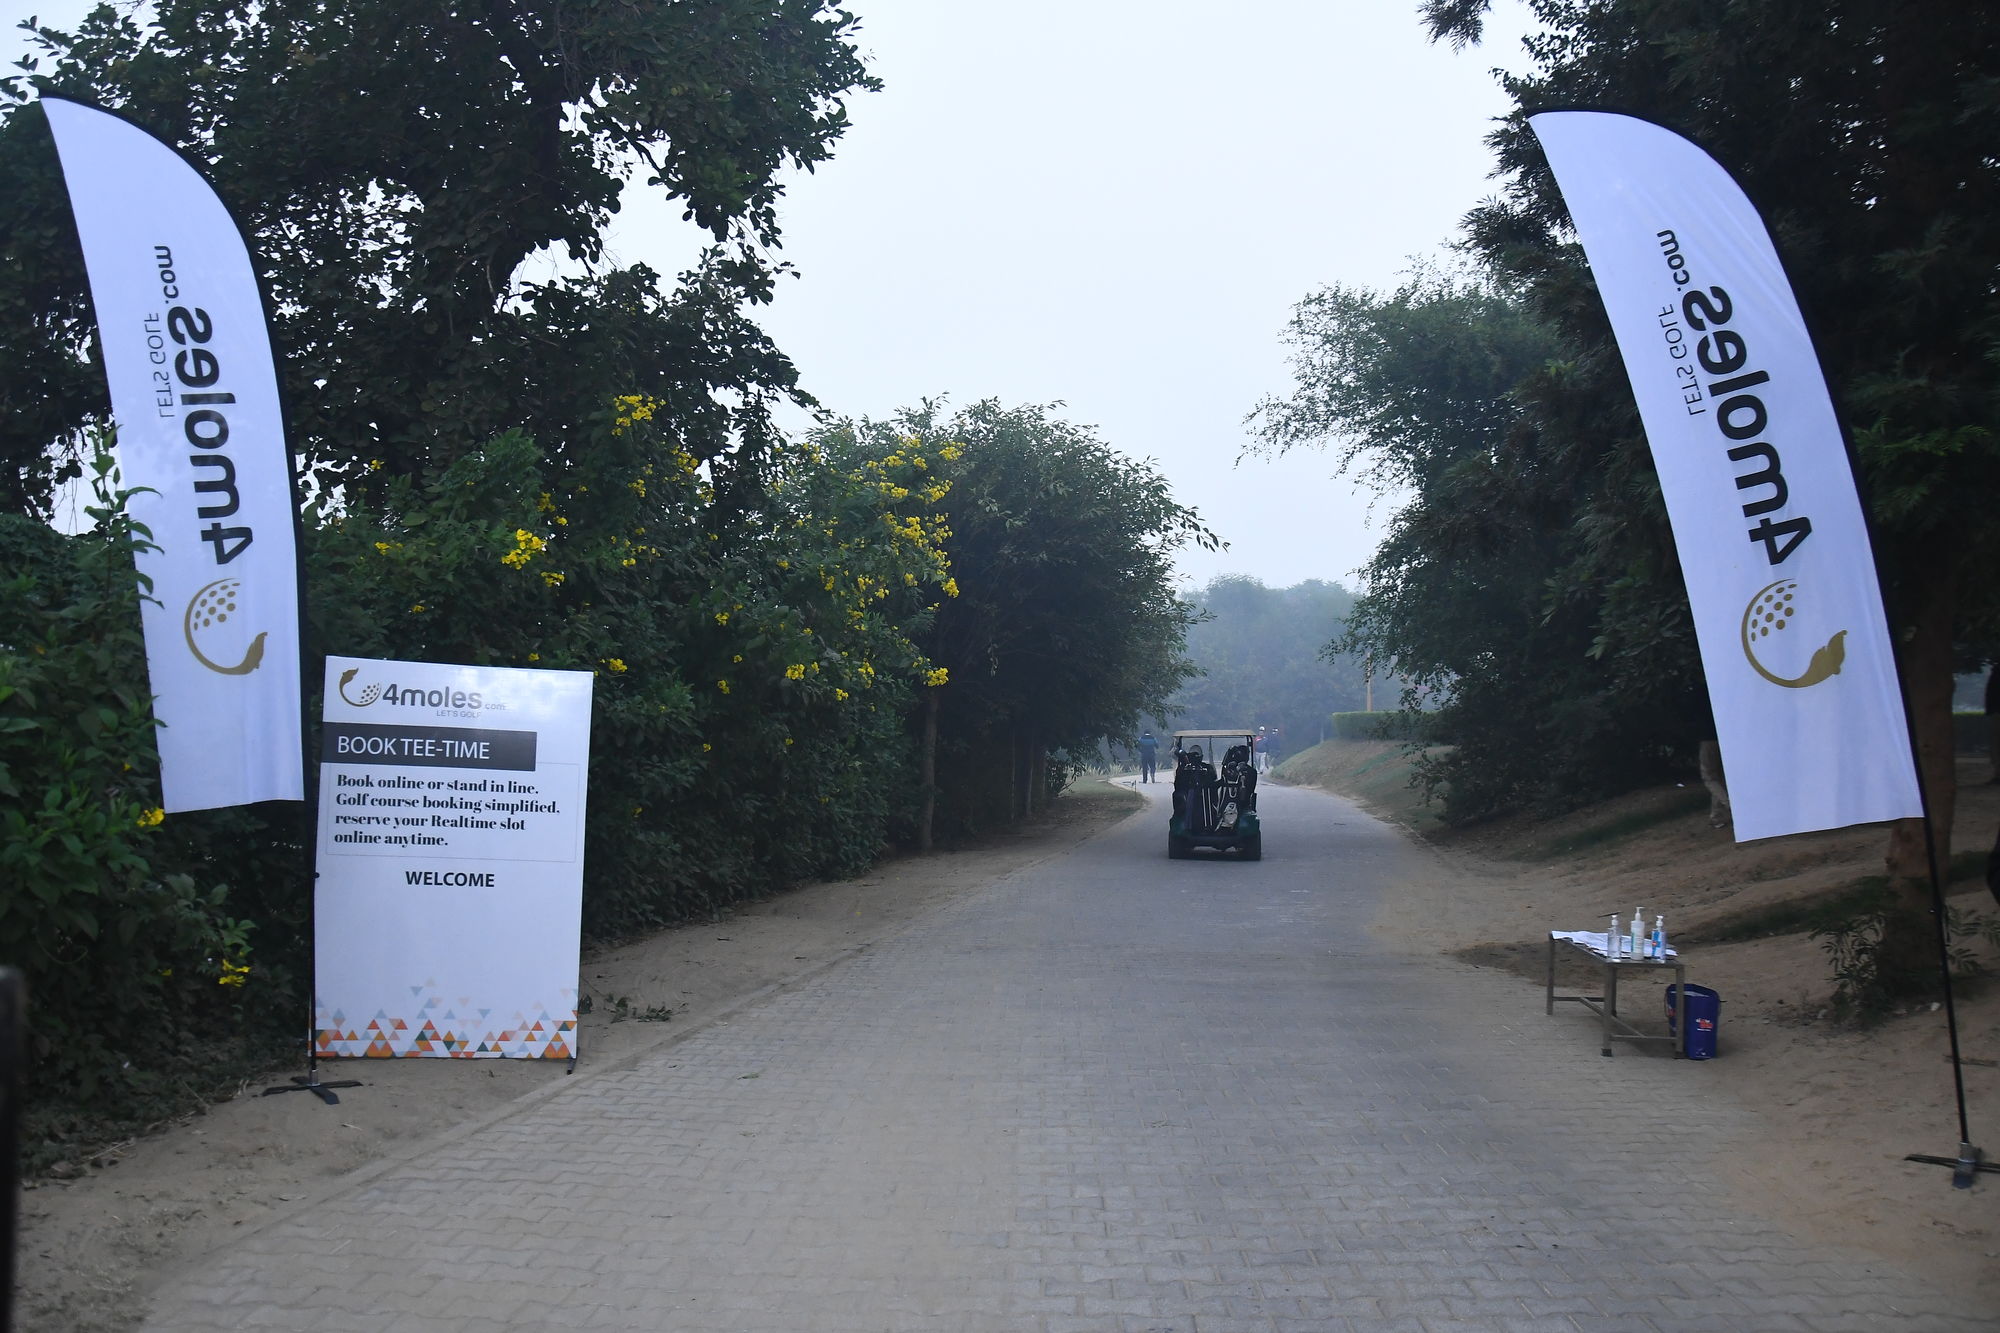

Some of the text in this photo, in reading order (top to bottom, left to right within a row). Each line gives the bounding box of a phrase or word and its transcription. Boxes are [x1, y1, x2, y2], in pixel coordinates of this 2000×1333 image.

[382, 683, 507, 711] 4molescom
[337, 736, 490, 759] BOOK TEE-TIME
[336, 774, 539, 795] Book online or stand in line.
[336, 792, 369, 807] Golf
[370, 797, 419, 808] course
[423, 796, 482, 814] booking
[335, 815, 525, 831] reserve your Realtime slot
[334, 831, 449, 848] online anytime.
[405, 871, 495, 887] WELCOME
